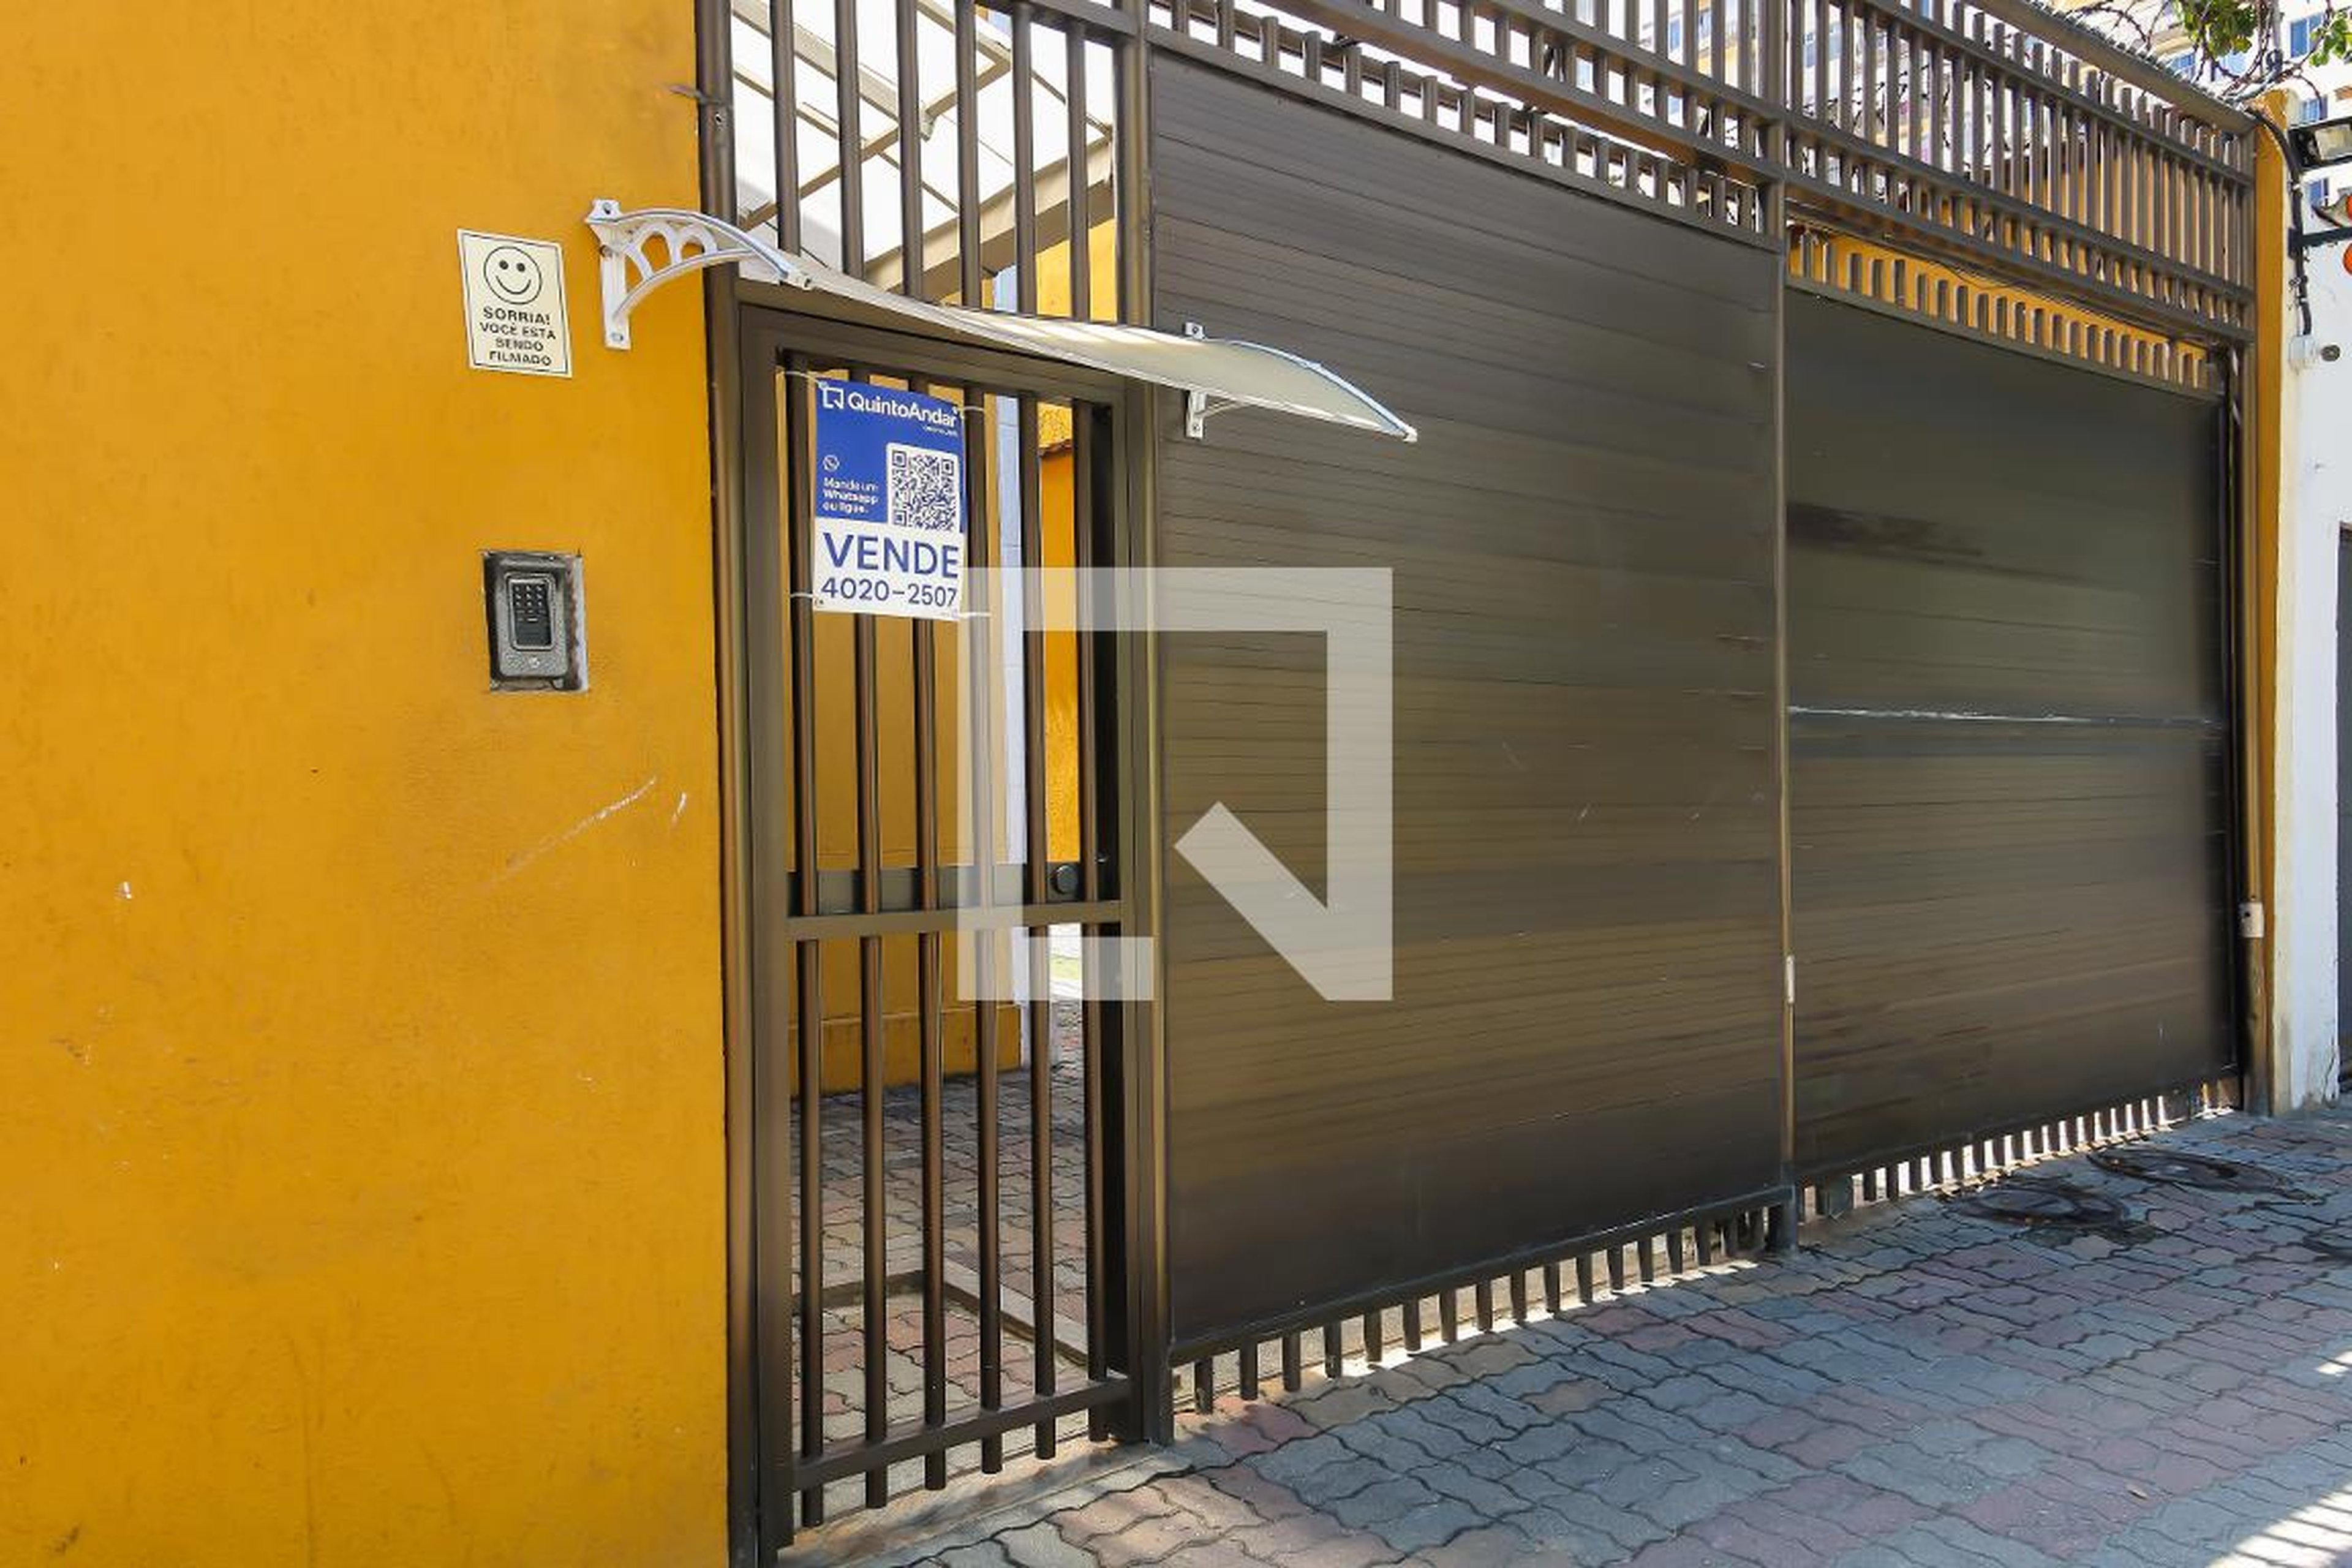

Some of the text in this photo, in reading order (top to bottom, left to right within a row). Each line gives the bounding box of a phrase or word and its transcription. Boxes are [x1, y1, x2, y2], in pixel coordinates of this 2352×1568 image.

[483, 306, 550, 325] SORRIA!
[496, 337, 544, 352] SENDO
[490, 351, 552, 366] FILMADO
[848, 392, 957, 427] QuintoAndar
[823, 532, 959, 579] VENDE
[821, 577, 958, 607] 4020-2507
